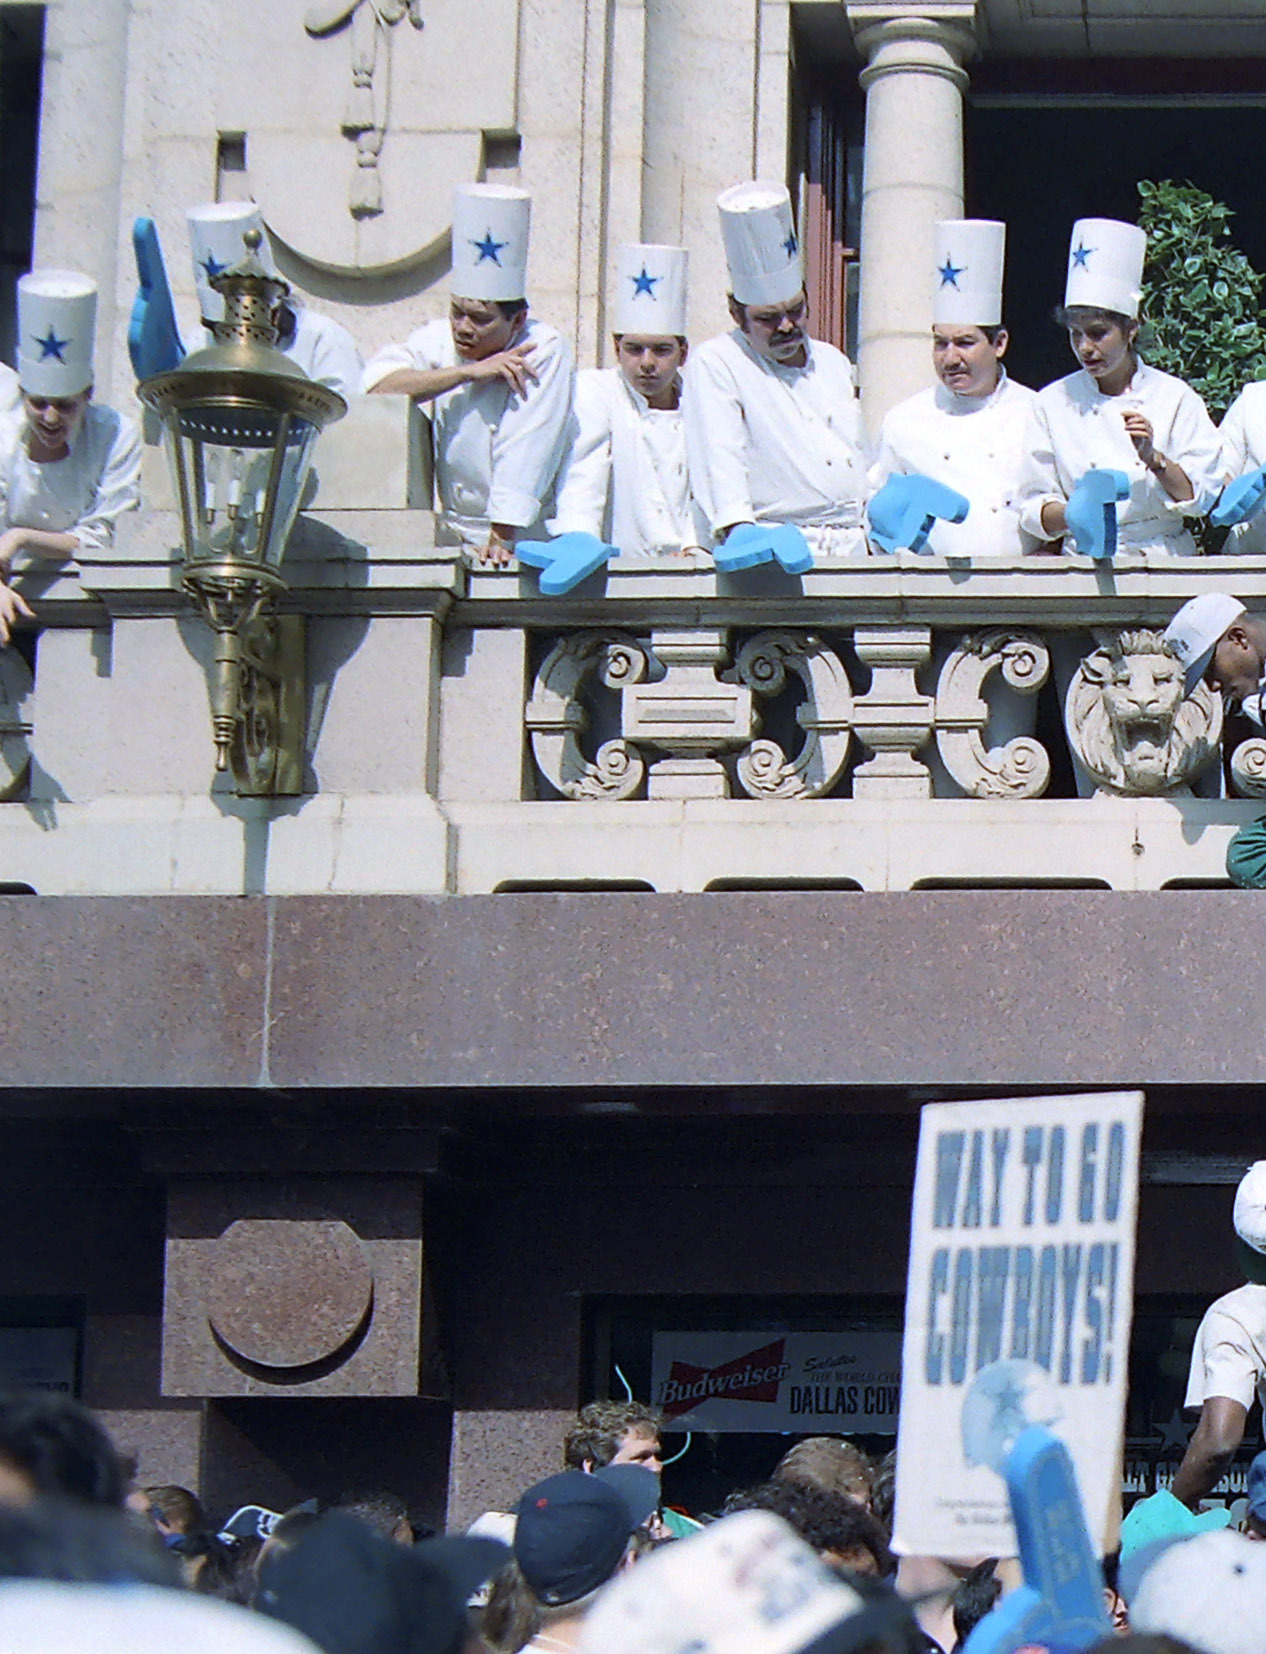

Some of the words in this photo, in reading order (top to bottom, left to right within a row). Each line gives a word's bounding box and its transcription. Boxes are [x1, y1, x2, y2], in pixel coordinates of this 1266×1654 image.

[933, 1128, 1009, 1229] WAY
[1022, 1123, 1066, 1227] TO
[1077, 1121, 1124, 1224] GO
[924, 1242, 1120, 1386] COWBOYS!
[659, 1362, 791, 1405] Budweiser
[790, 1386, 859, 1415] DALLAS
